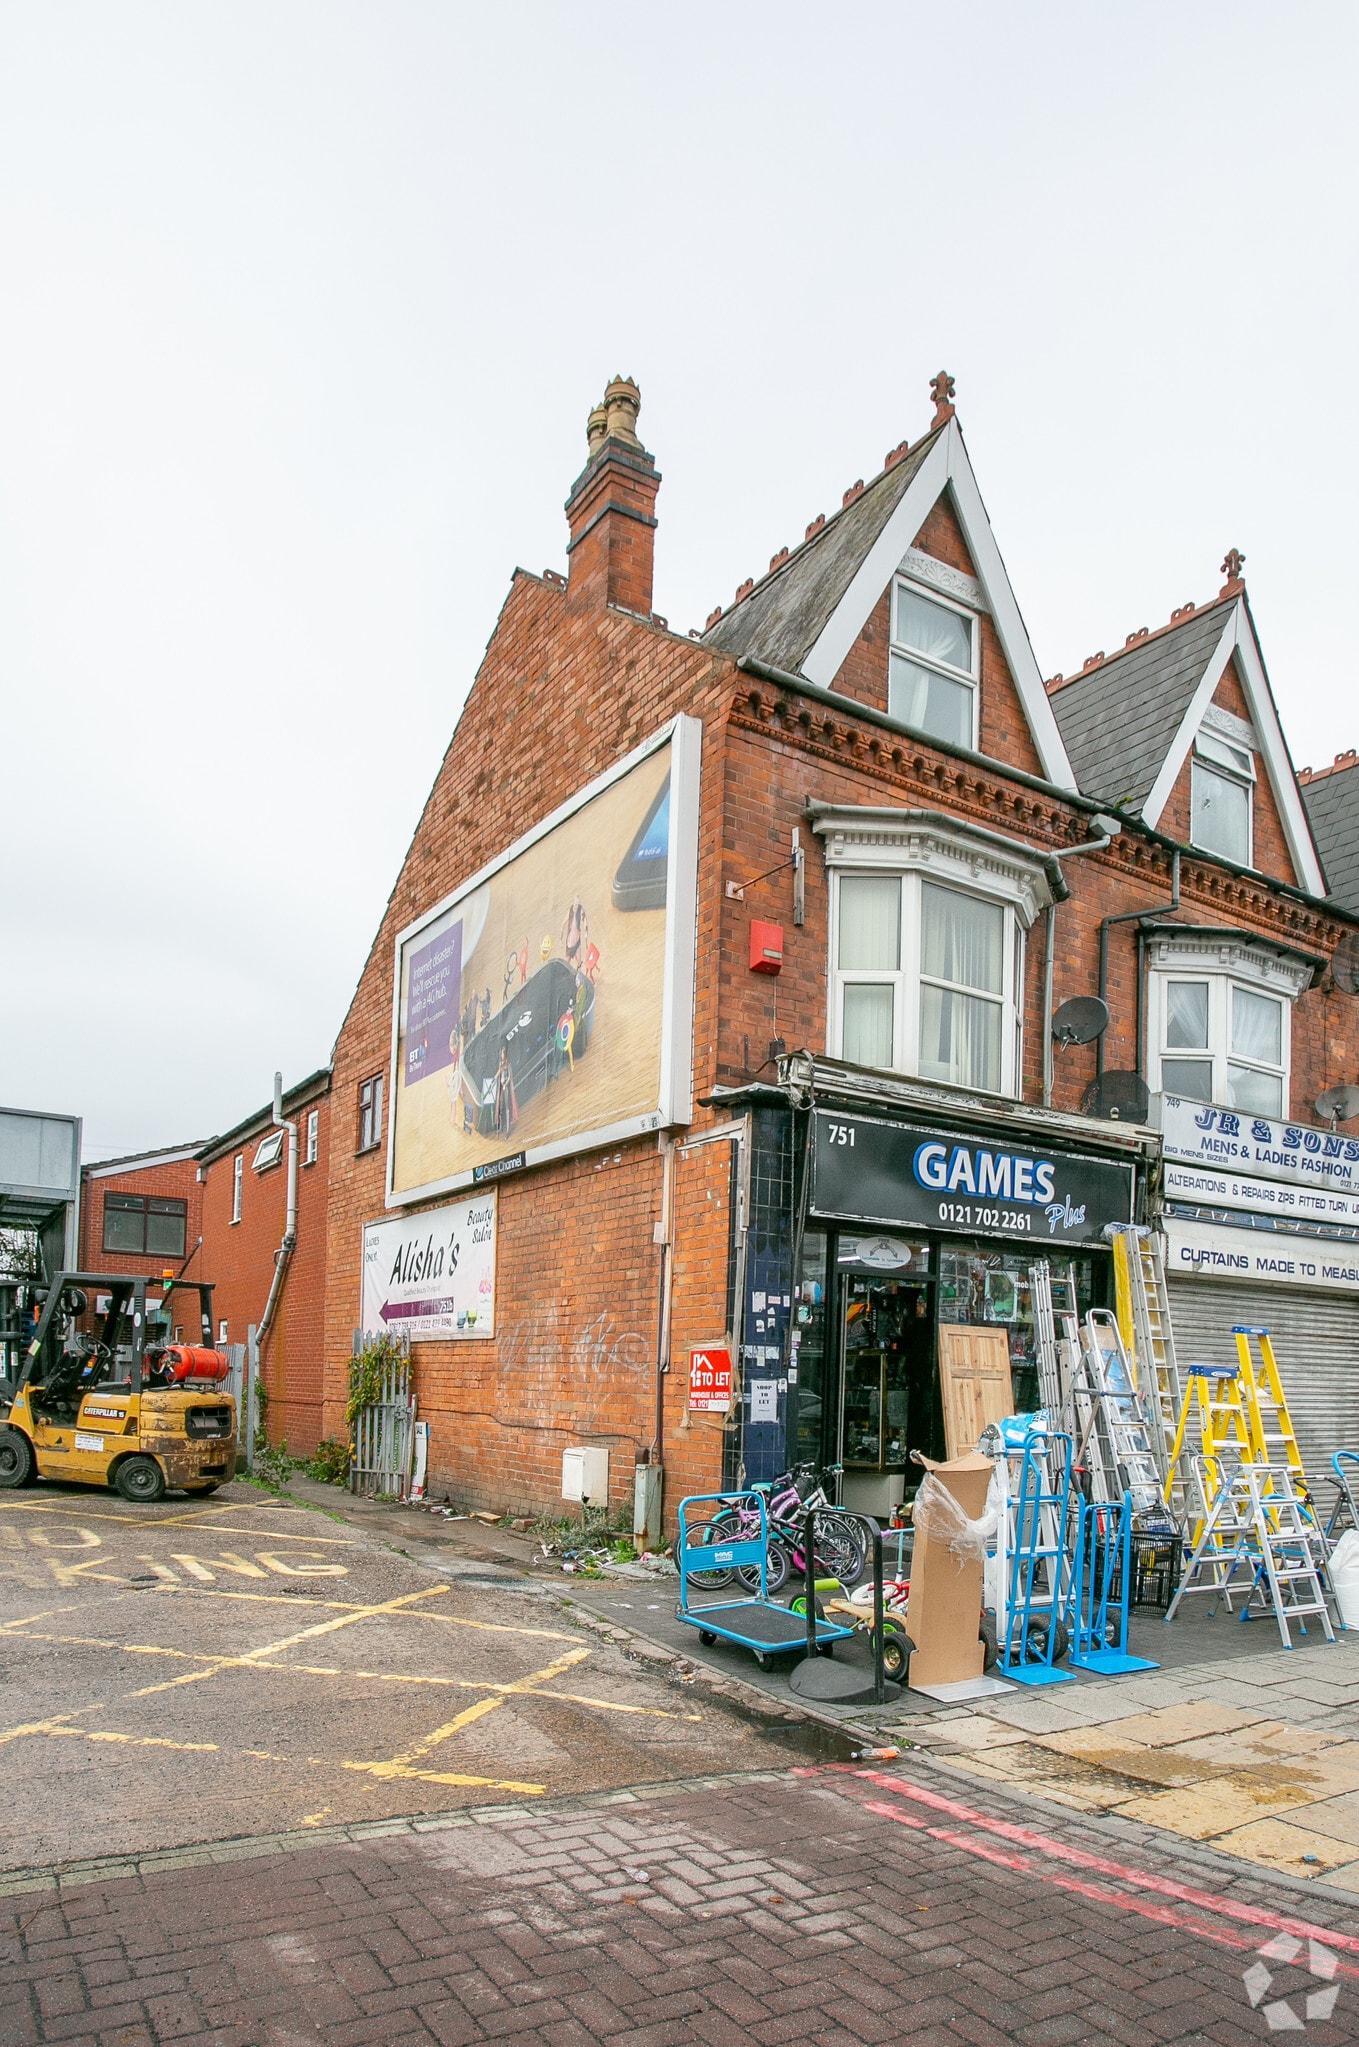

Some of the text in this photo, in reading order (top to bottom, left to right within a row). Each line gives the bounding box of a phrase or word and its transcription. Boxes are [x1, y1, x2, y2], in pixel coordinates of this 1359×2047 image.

[413, 959, 432, 980] Internet
[423, 970, 440, 992] rescue
[440, 964, 450, 984] you
[505, 1023, 519, 1041] BT
[409, 1048, 419, 1063] BT
[1166, 1096, 1181, 1108] 749
[828, 1124, 856, 1147] 751
[1194, 1108, 1359, 1162] JR & SONS
[483, 1153, 522, 1177] Clear Channel
[1164, 1145, 1229, 1164] BIG MENS SIZES
[1201, 1136, 1352, 1179] MENS & LADIES FASHION
[913, 1141, 1056, 1206] GAMES
[1167, 1173, 1227, 1194] ALTERATIONS
[1232, 1184, 1239, 1196] &
[1241, 1185, 1276, 1202] REPAIRS
[1278, 1191, 1296, 1205] ZIPS
[1298, 1195, 1327, 1210] FITTED
[1328, 1199, 1349, 1213] TURN
[467, 1206, 494, 1228] Beauty
[938, 1202, 1031, 1231] 0121 702 2261
[1045, 1193, 1087, 1234] Plus
[472, 1226, 492, 1244] Salon
[389, 1231, 460, 1287] Alisha's
[1180, 1247, 1249, 1269] CURTAINS
[1256, 1257, 1295, 1273] MADE
[1299, 1262, 1316, 1276] TO
[701, 1371, 731, 1386] TO LET
[84, 1406, 118, 1418] CATERPILLAR
